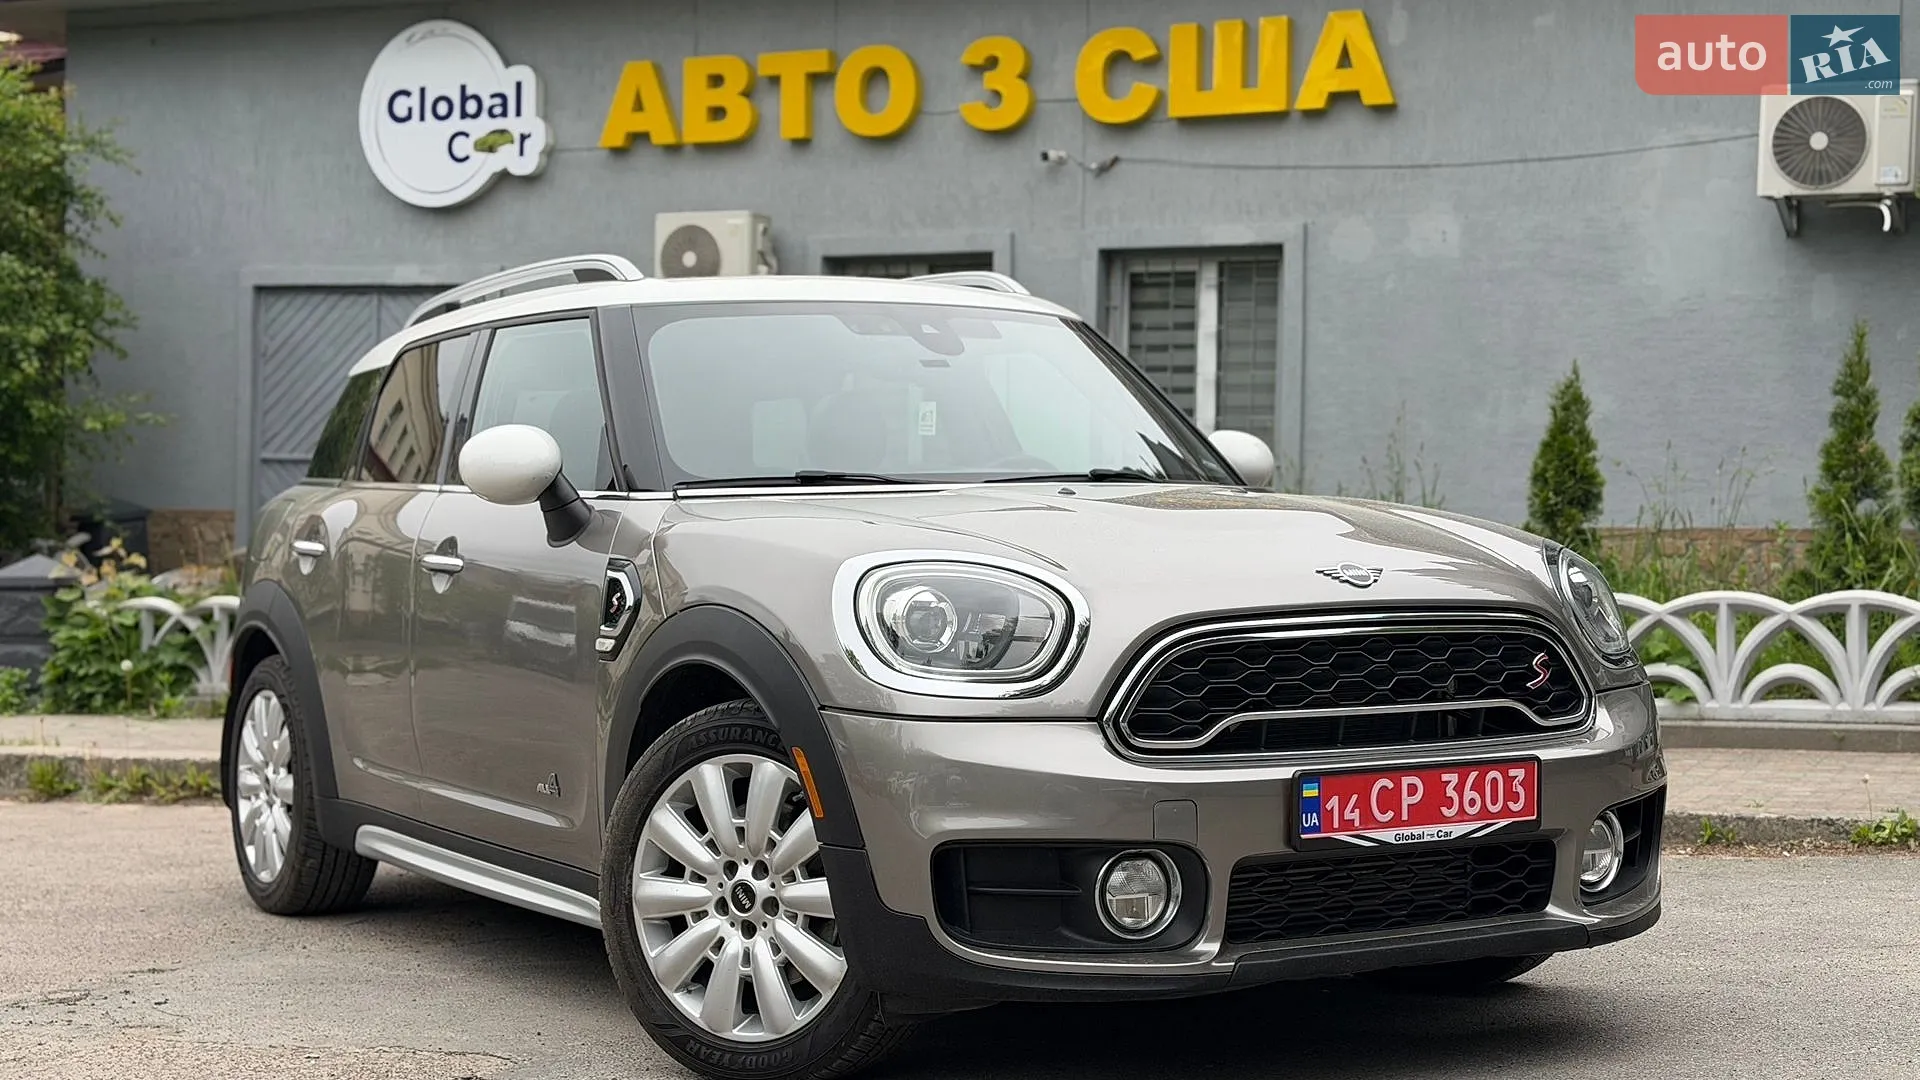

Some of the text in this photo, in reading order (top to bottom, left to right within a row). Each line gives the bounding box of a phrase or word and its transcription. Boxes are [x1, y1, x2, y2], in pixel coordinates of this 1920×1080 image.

[599, 44, 922, 149] АВТО
[1074, 9, 1397, 125] США
[387, 81, 523, 124] Global
[448, 130, 532, 163] Cr
[1439, 768, 1526, 818] 3603
[1302, 812, 1319, 828] UA
[1394, 829, 1453, 842] Global Car
[735, 886, 752, 909] MINI
